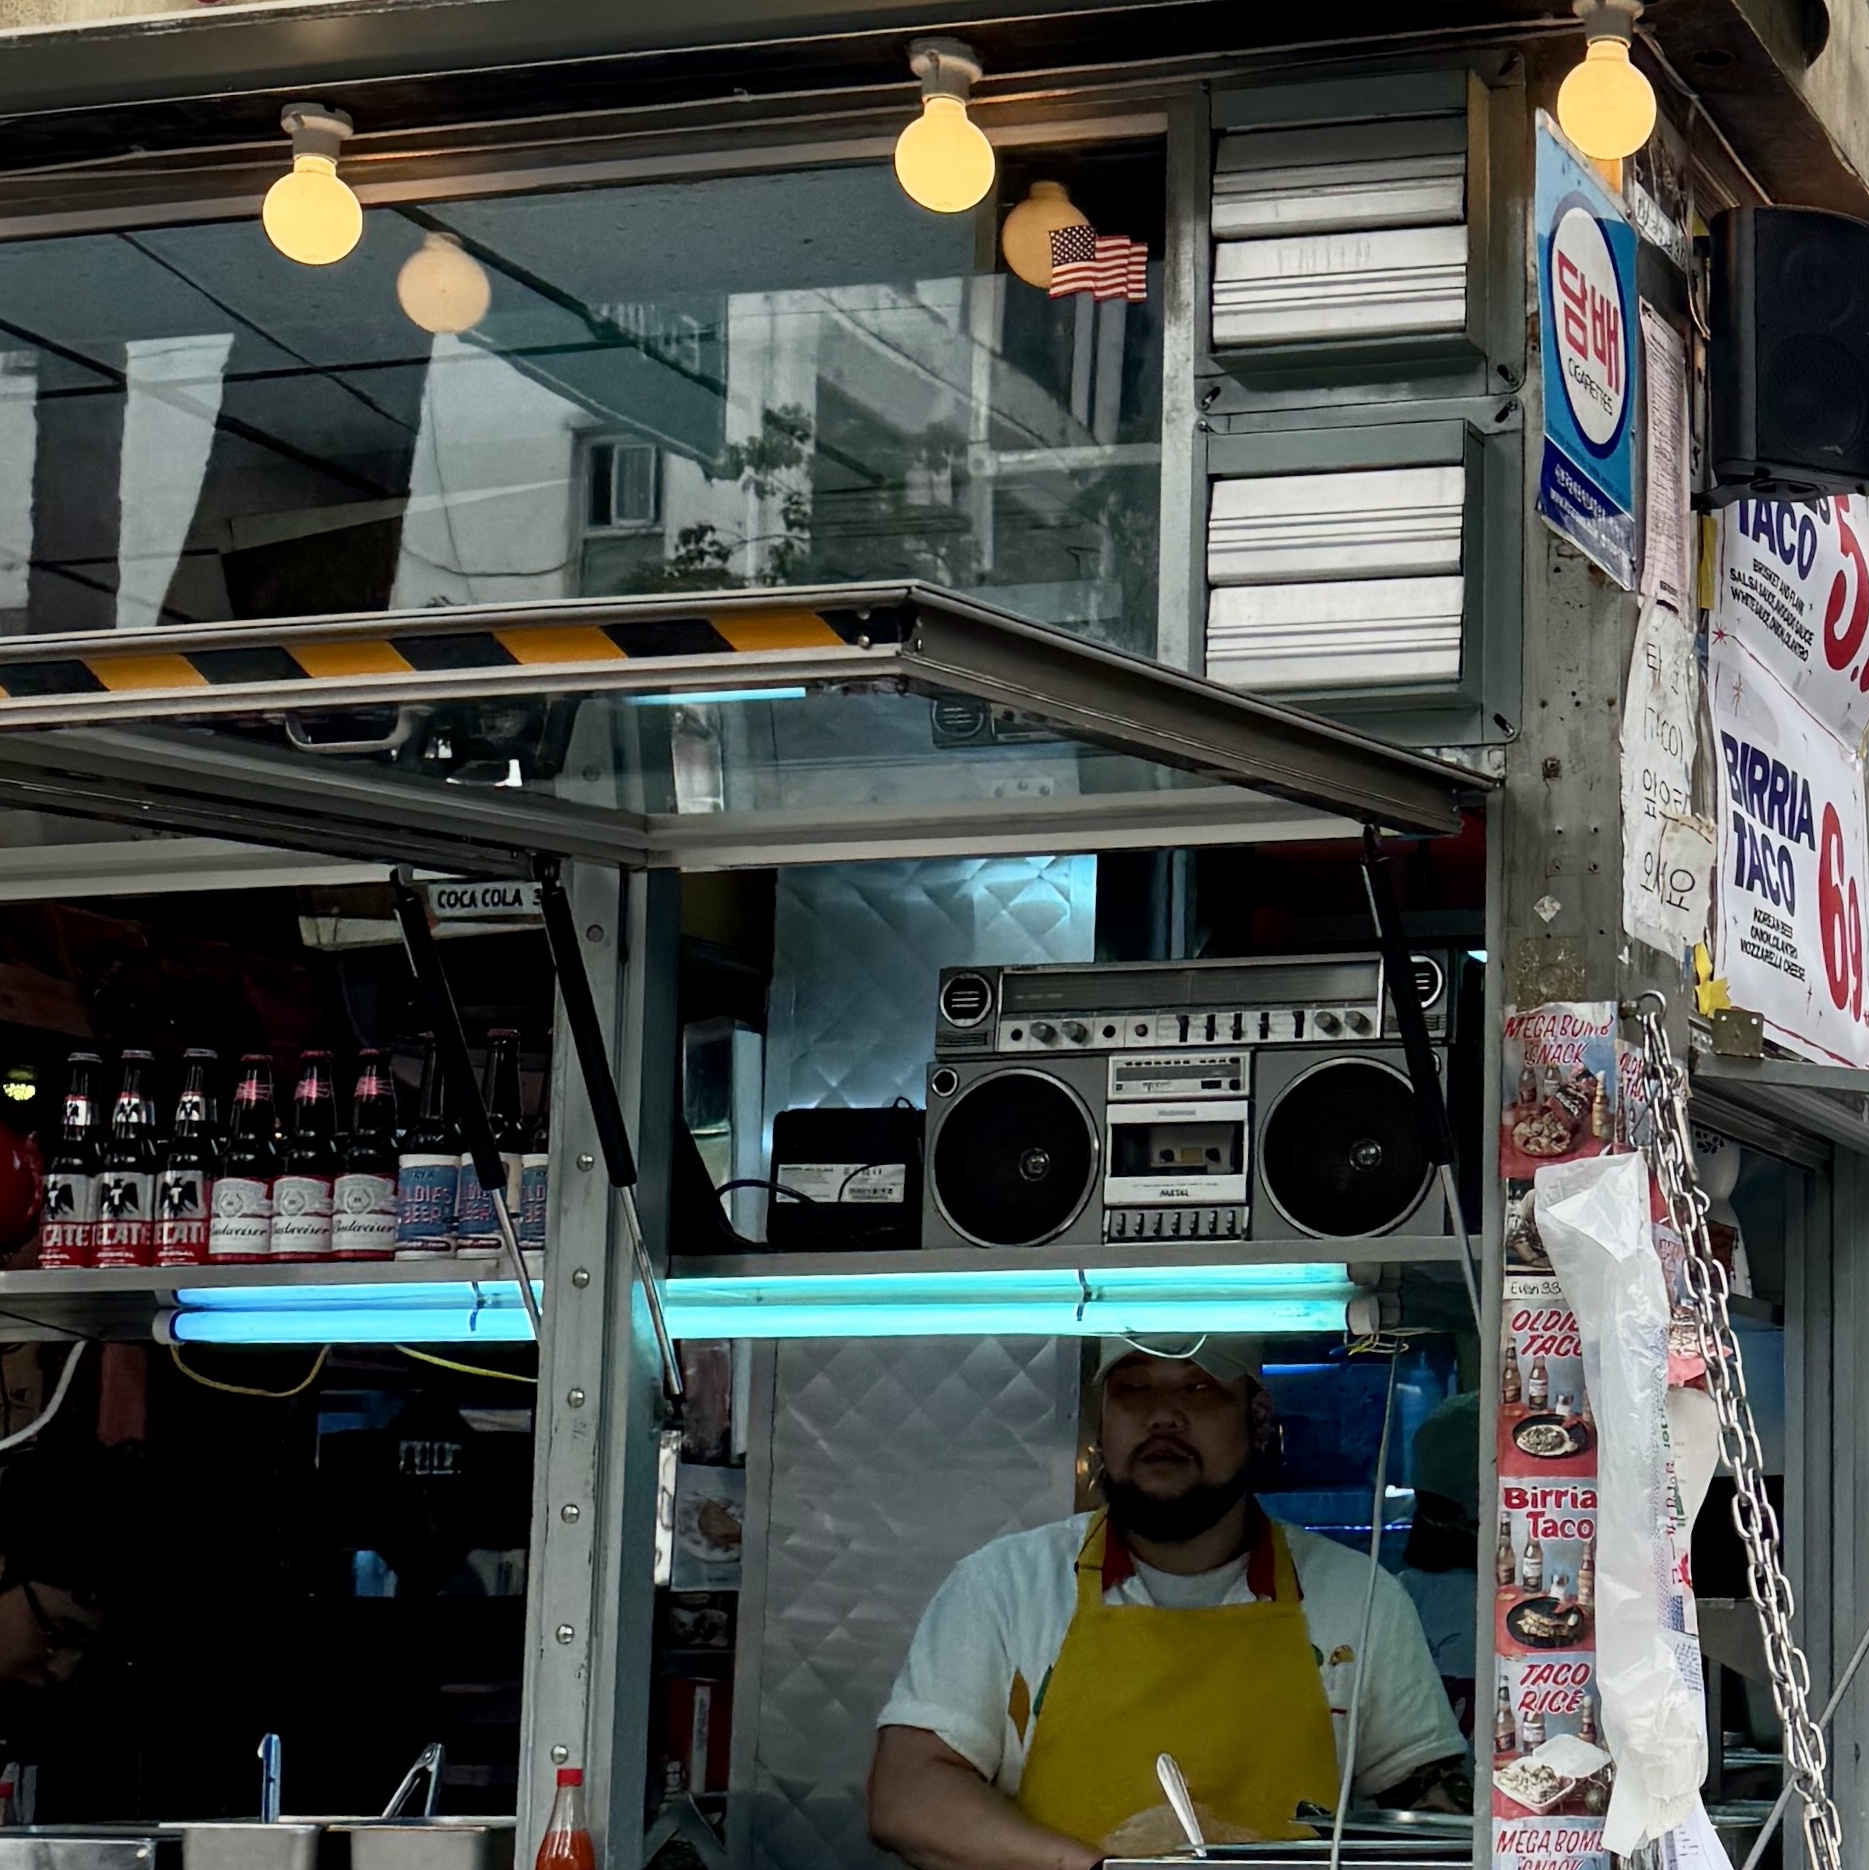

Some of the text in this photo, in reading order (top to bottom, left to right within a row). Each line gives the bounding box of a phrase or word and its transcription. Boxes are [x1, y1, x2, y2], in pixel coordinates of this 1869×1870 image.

[1557, 249, 1619, 396] 담배
[1720, 730, 1817, 852] BIRRIA
[1732, 809, 1796, 918] TACO
[437, 888, 524, 909] COCA COLA
[1504, 1013, 1555, 1039] MEGA
[1525, 1041, 1589, 1066] SNACK
[1503, 1486, 1598, 1512] Birria
[1526, 1510, 1595, 1542] Taco
[1518, 1661, 1590, 1689] TACO
[1516, 1686, 1582, 1716] RICE
[1496, 1827, 1554, 1855] MEGA
